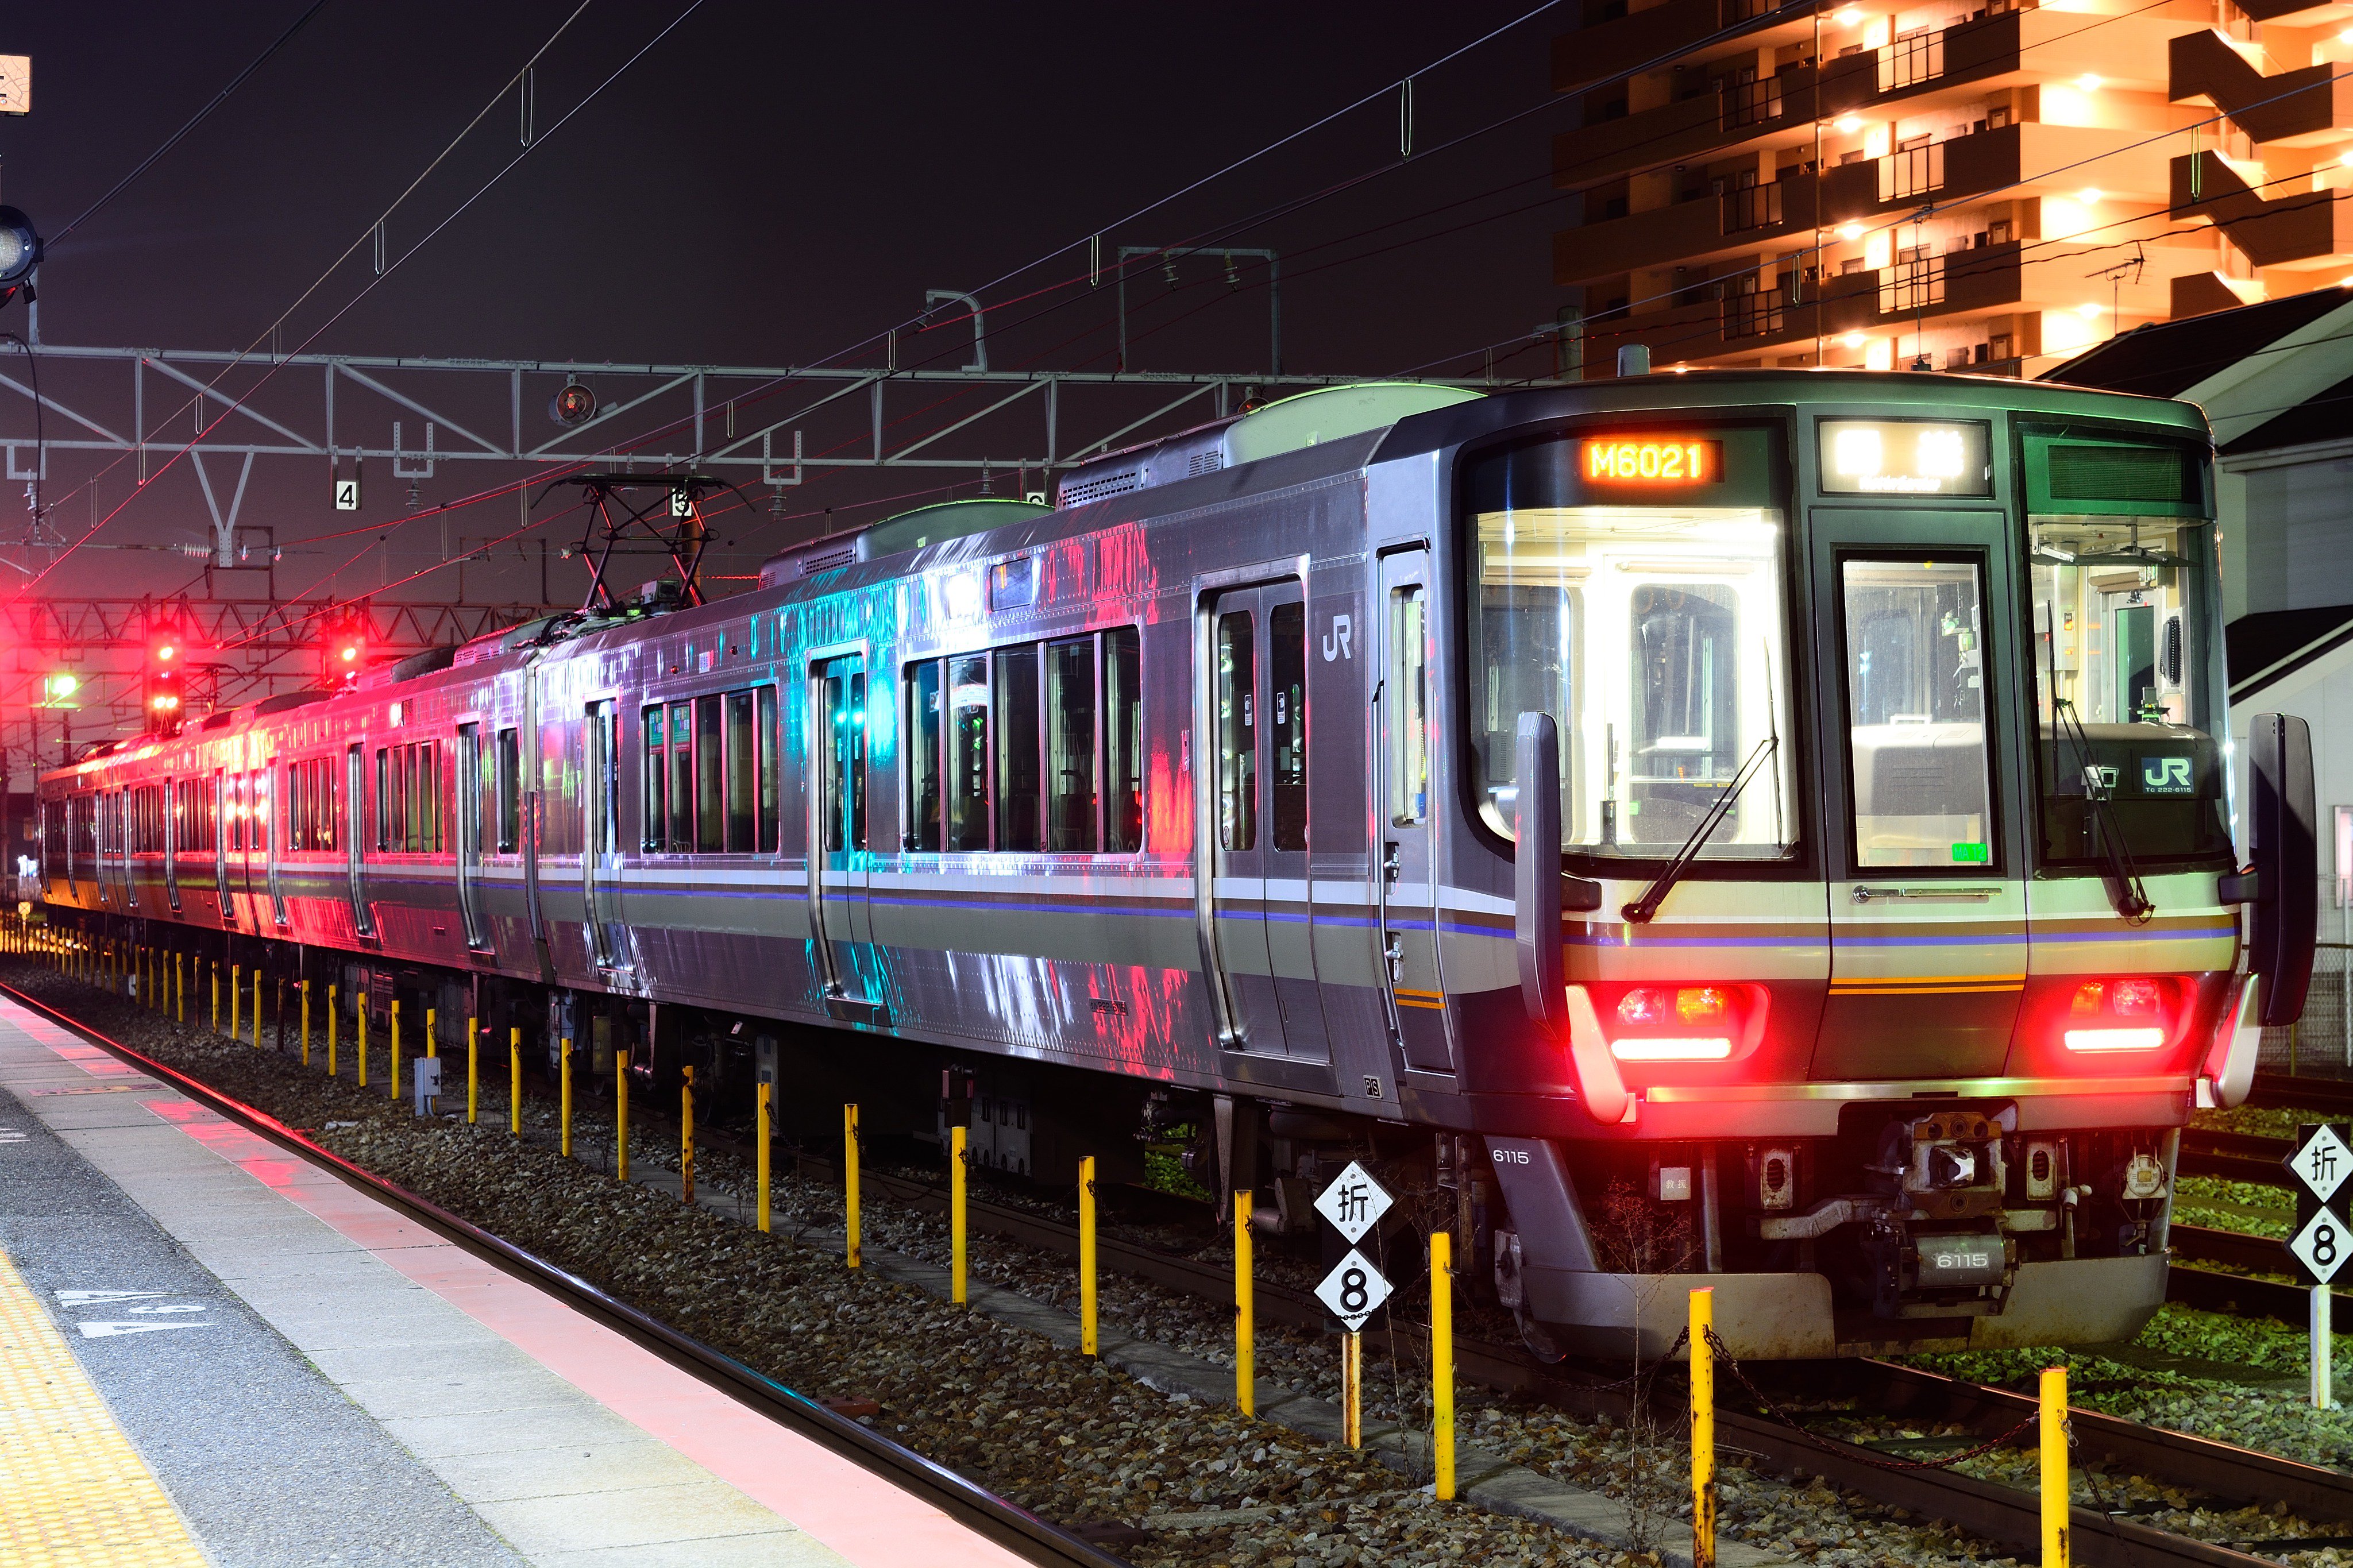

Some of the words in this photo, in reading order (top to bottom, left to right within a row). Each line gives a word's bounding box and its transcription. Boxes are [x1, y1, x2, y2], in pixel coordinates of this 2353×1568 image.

[1590, 443, 1702, 478] M6021
[339, 484, 354, 507] 4
[1323, 614, 1351, 662] JR
[2145, 758, 2190, 786] JR
[1954, 846, 1970, 859] MA
[1972, 846, 1985, 859] 12
[1365, 1079, 1379, 1095] PS
[1493, 1149, 1529, 1164] 6115
[2311, 1145, 2337, 1181] 折
[1337, 1184, 1368, 1222] 折
[2312, 1224, 2337, 1266] 8
[1937, 1254, 1988, 1268] 6115
[1340, 1268, 1368, 1313] 8
